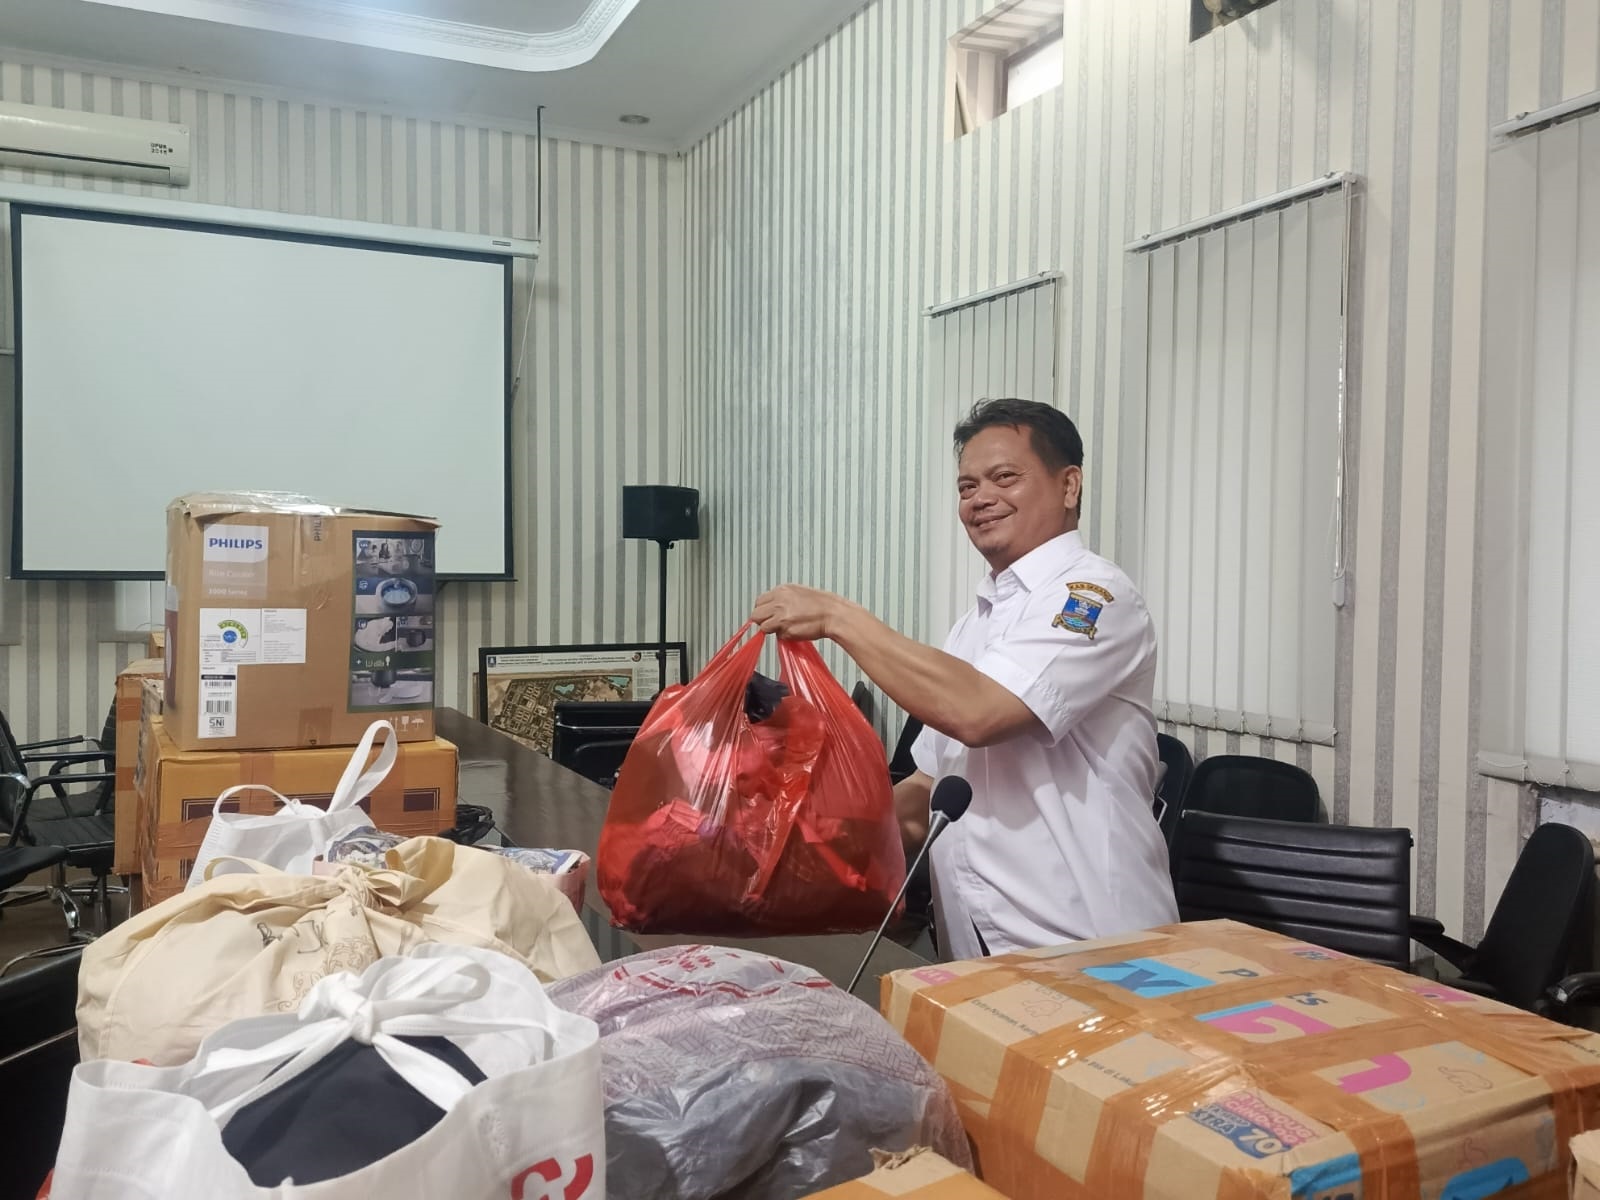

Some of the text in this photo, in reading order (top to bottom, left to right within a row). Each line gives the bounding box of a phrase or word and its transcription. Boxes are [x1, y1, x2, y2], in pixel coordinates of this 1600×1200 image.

[209, 538, 263, 550] PHILIPS
[208, 718, 226, 728] SNI
[1238, 1127, 1284, 1154] 70
